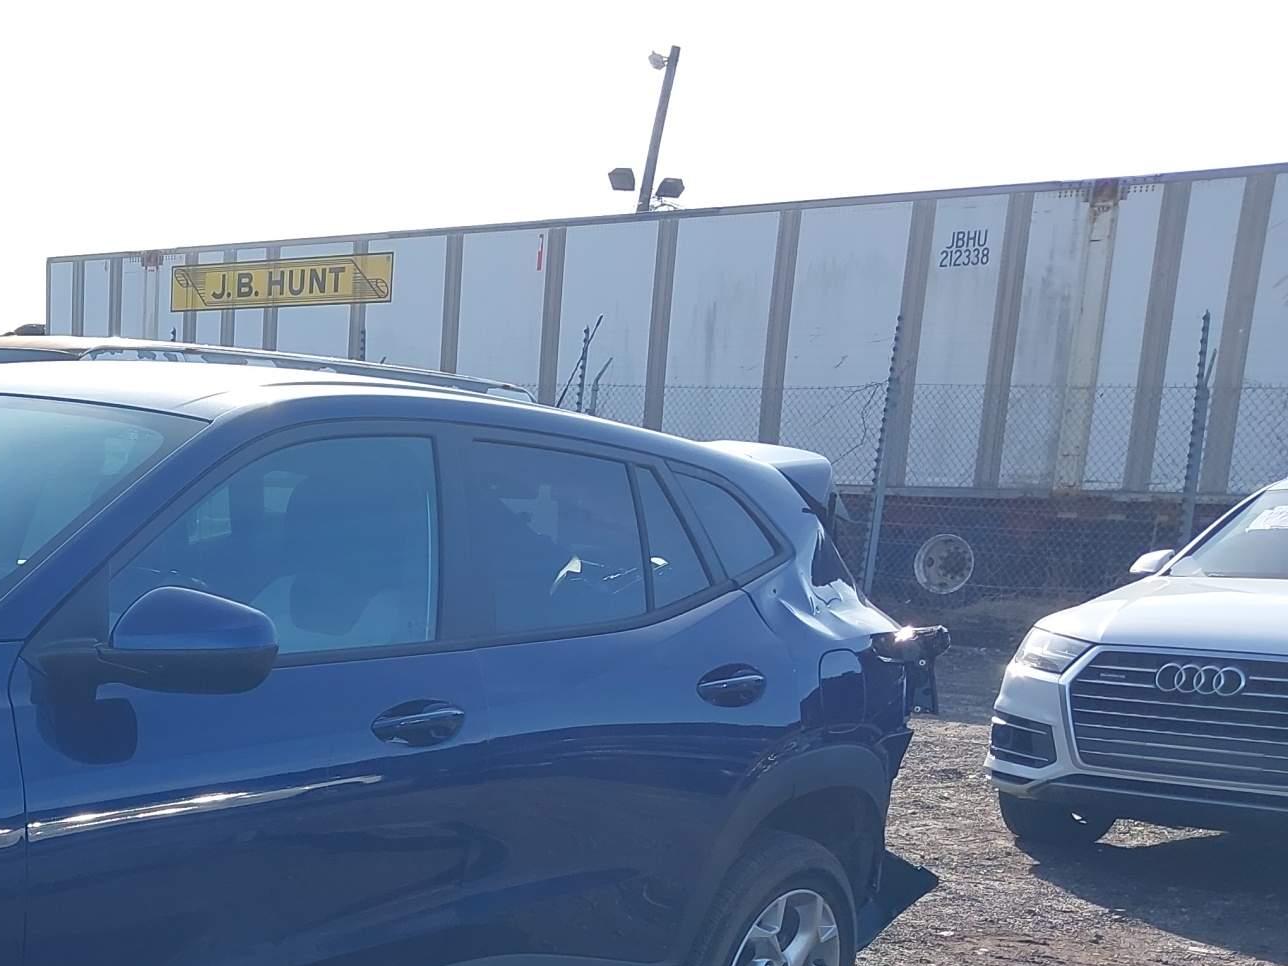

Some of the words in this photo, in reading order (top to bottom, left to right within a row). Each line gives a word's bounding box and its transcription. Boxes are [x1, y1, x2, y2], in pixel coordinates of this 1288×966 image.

[946, 229, 989, 249] JBHU
[939, 248, 990, 268] 212338
[267, 266, 347, 297] HUNT
